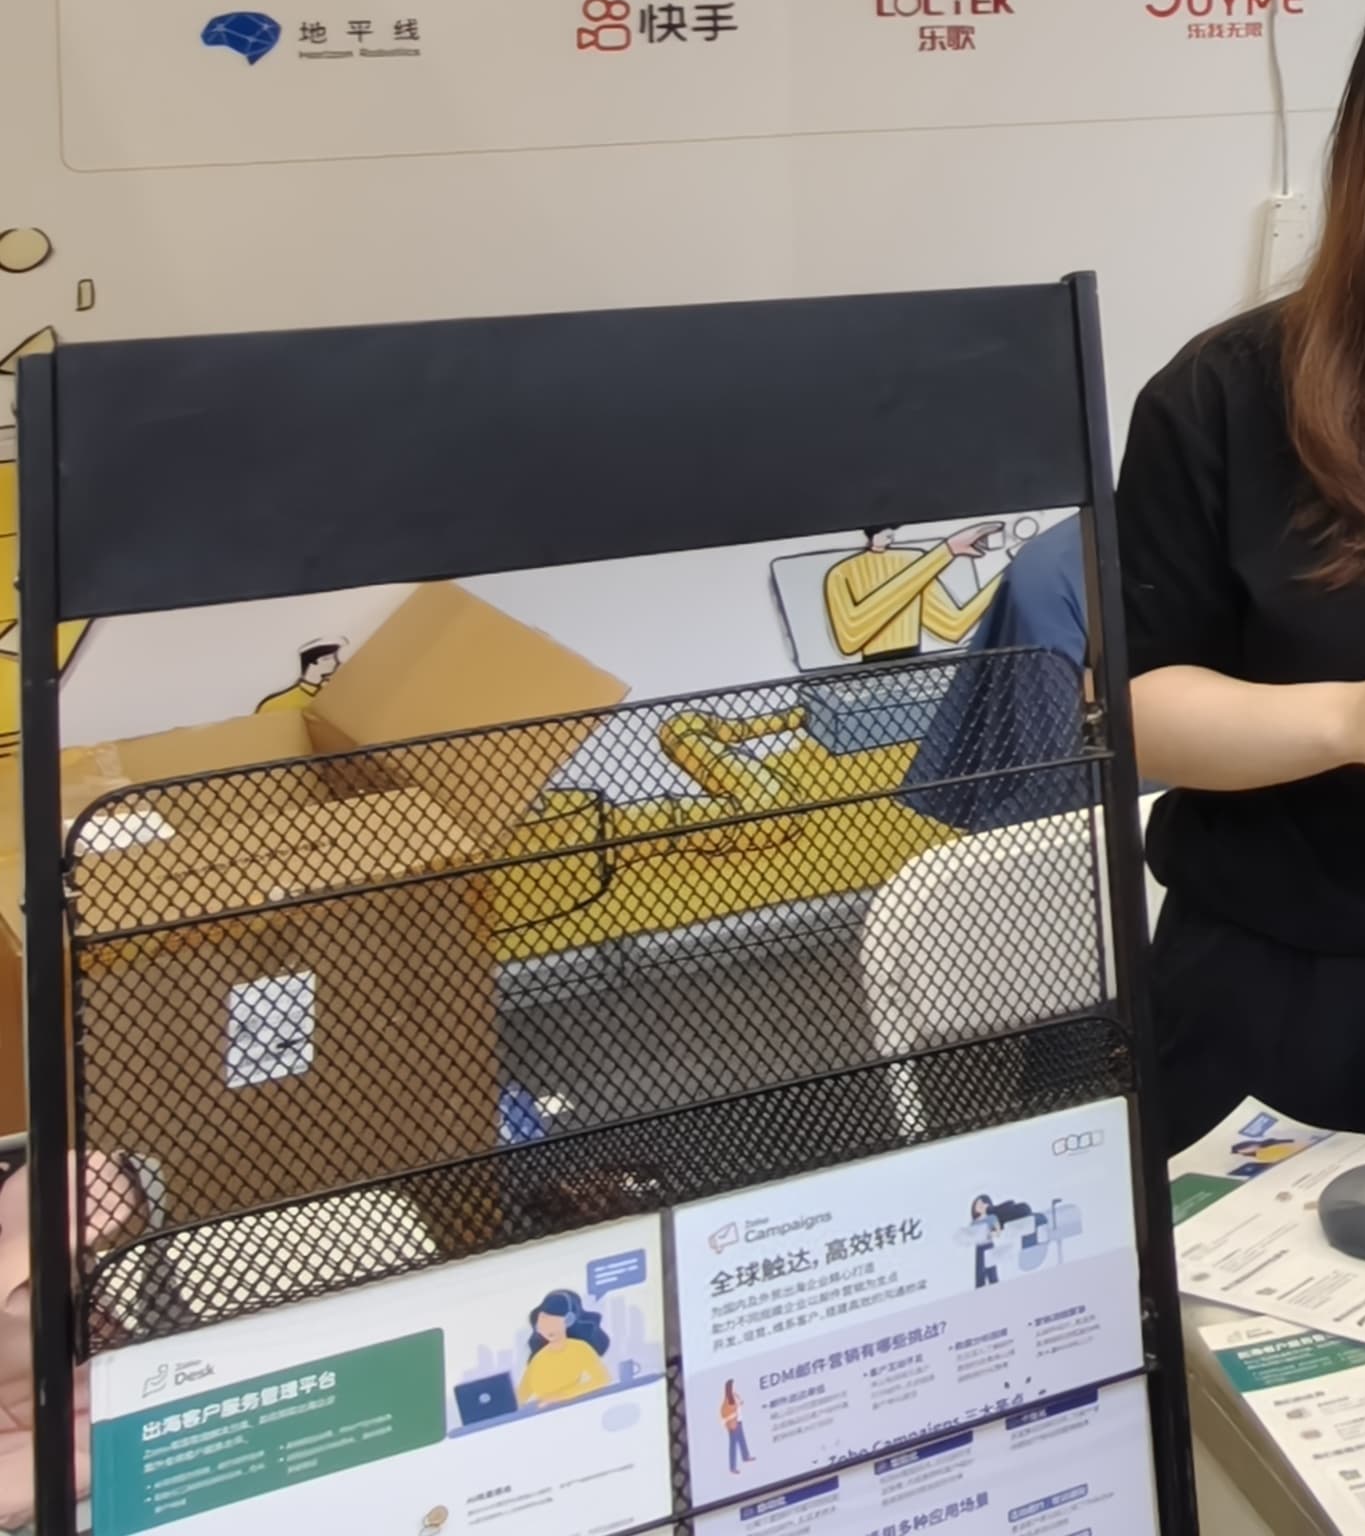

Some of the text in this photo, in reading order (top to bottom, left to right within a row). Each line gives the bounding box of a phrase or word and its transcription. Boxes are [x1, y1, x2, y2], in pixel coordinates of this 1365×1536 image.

[299, 18, 422, 43] 地平线
[639, 2, 739, 43] 快手
[918, 26, 977, 53] 乐歌
[744, 1211, 833, 1244] Campaigns
[173, 1363, 217, 1387] Desk
